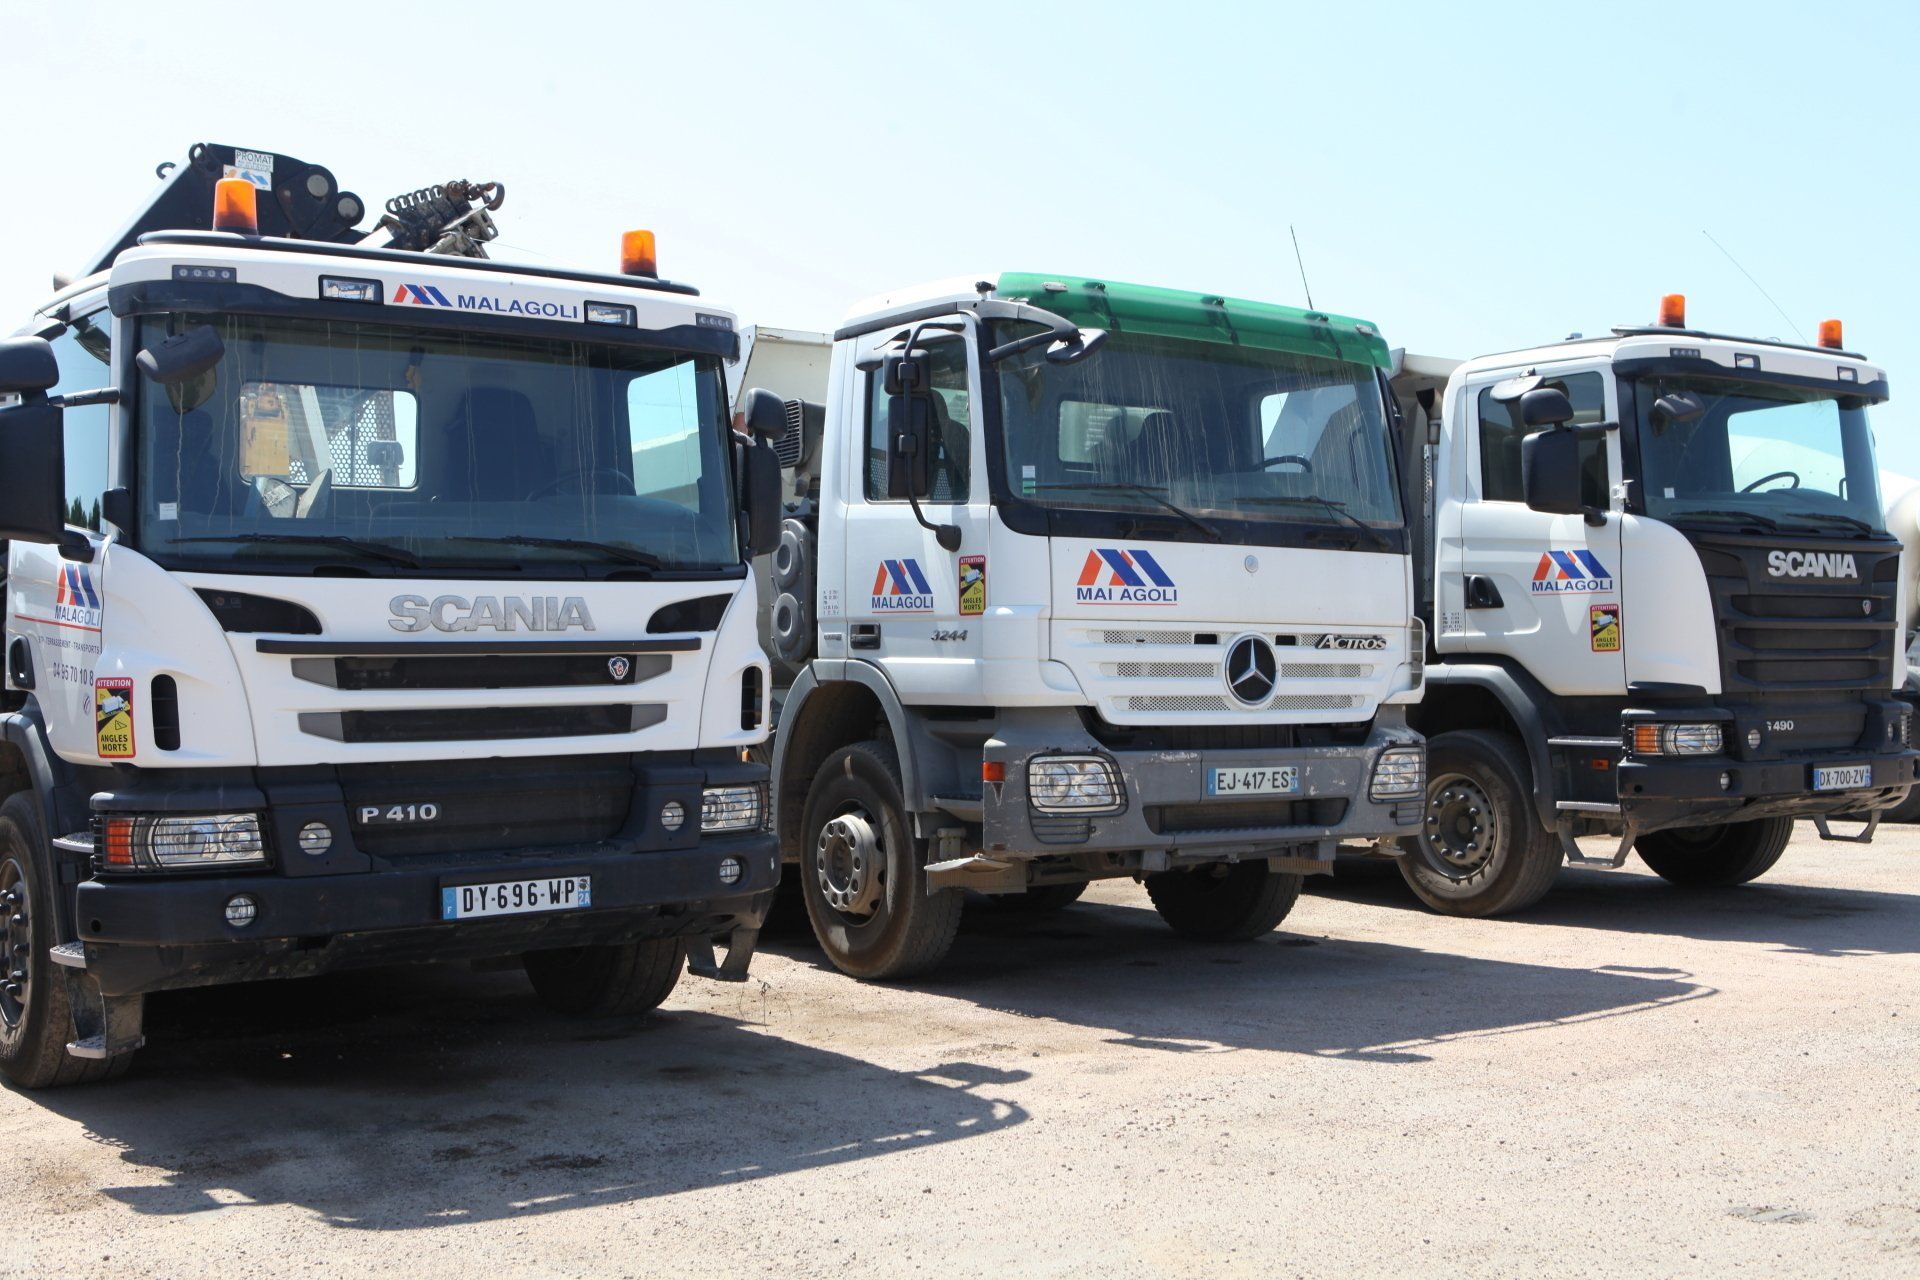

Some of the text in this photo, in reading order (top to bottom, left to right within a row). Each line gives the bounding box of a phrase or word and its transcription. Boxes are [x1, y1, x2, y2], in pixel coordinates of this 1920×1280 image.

[236, 151, 272, 164] PROMAT
[457, 294, 578, 319] MALAGOLI
[1767, 550, 1858, 578] SCANIA
[1532, 580, 1613, 592] MALAGOLI
[872, 596, 934, 609] MALAGOLI
[54, 604, 100, 627] MALAGOLI
[387, 594, 597, 633] SCANIA
[930, 630, 969, 641] 3244
[70, 666, 78, 683] 70
[80, 668, 88, 685] 10
[96, 679, 132, 687] ATTENTION
[1773, 720, 1794, 731] 490
[100, 734, 128, 743] ANGLES
[102, 743, 128, 752] MORTS
[362, 804, 437, 824] P 410
[462, 879, 575, 913] DY-696-WP
[578, 893, 590, 905] 2A
